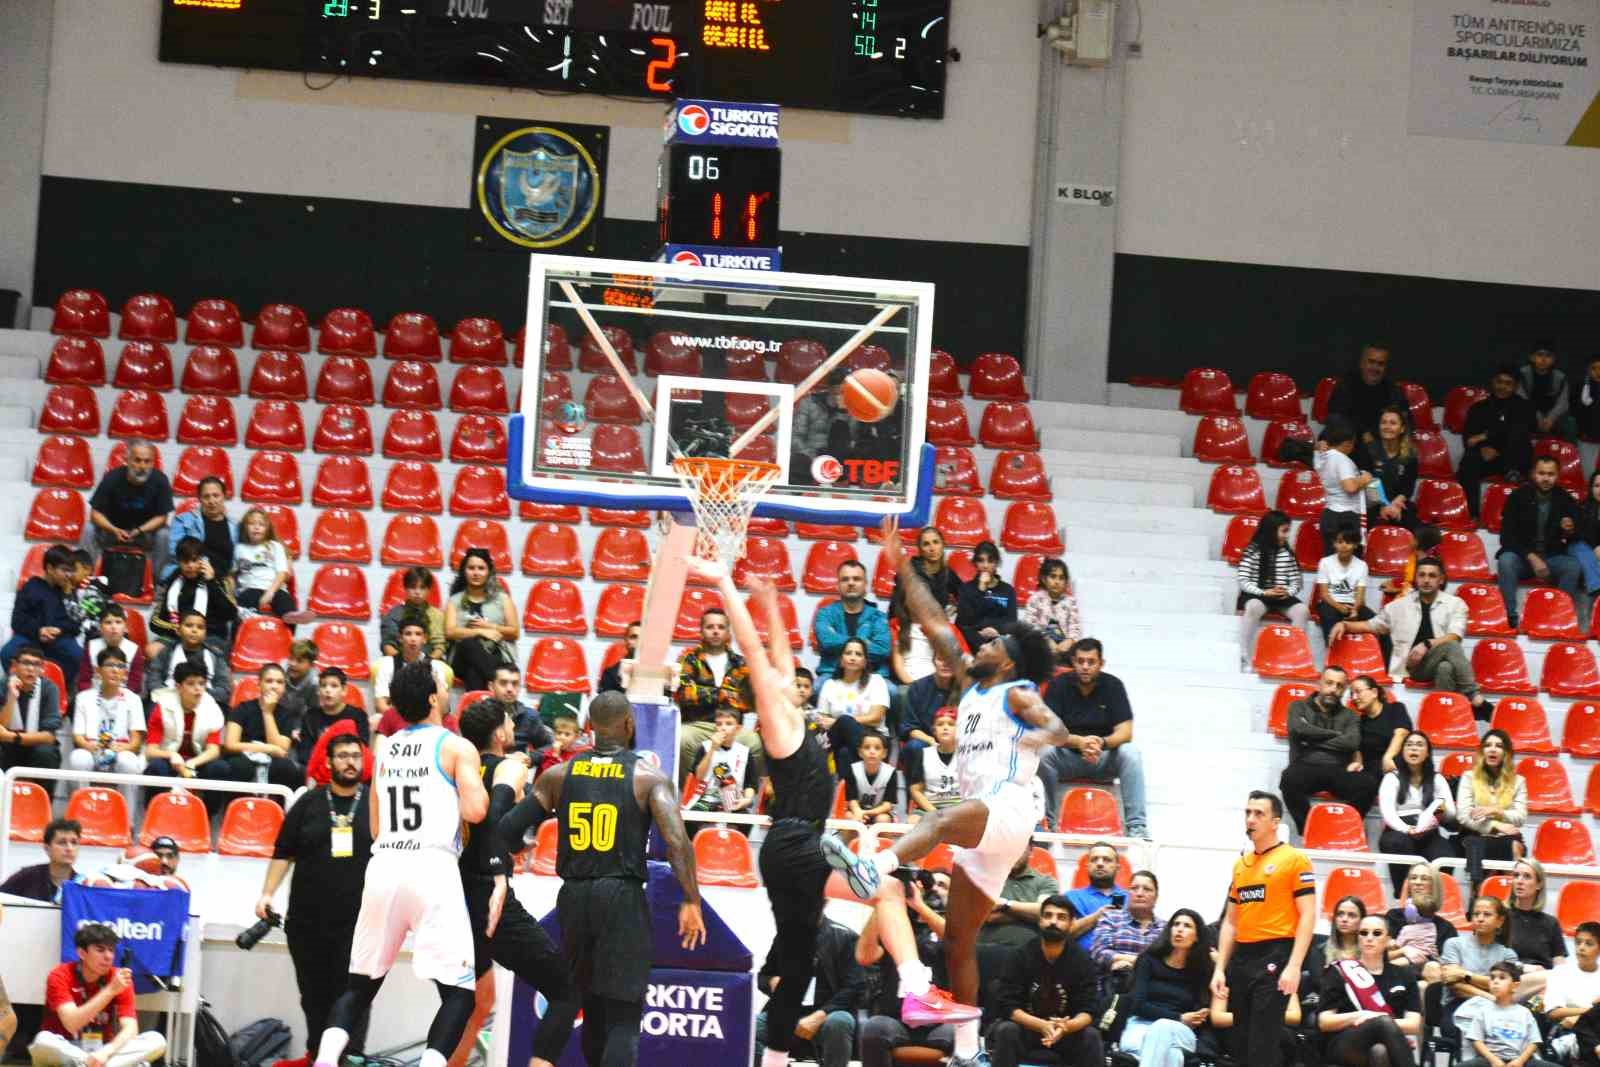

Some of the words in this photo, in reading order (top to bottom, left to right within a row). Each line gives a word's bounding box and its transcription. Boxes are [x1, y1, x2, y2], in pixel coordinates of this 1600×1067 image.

[543, 2, 574, 26] SET
[630, 4, 673, 33] FOUL
[1568, 24, 1585, 38] VE
[646, 38, 676, 92] 2
[1058, 187, 1069, 198] K
[670, 335, 783, 354] www.tbf.org.tr
[843, 458, 901, 485] TBF
[387, 785, 423, 833] 15
[569, 802, 618, 852] 50
[1501, 880, 1514, 889] 1
[645, 984, 724, 1011] RKİYE
[641, 1011, 724, 1039] ORTA
